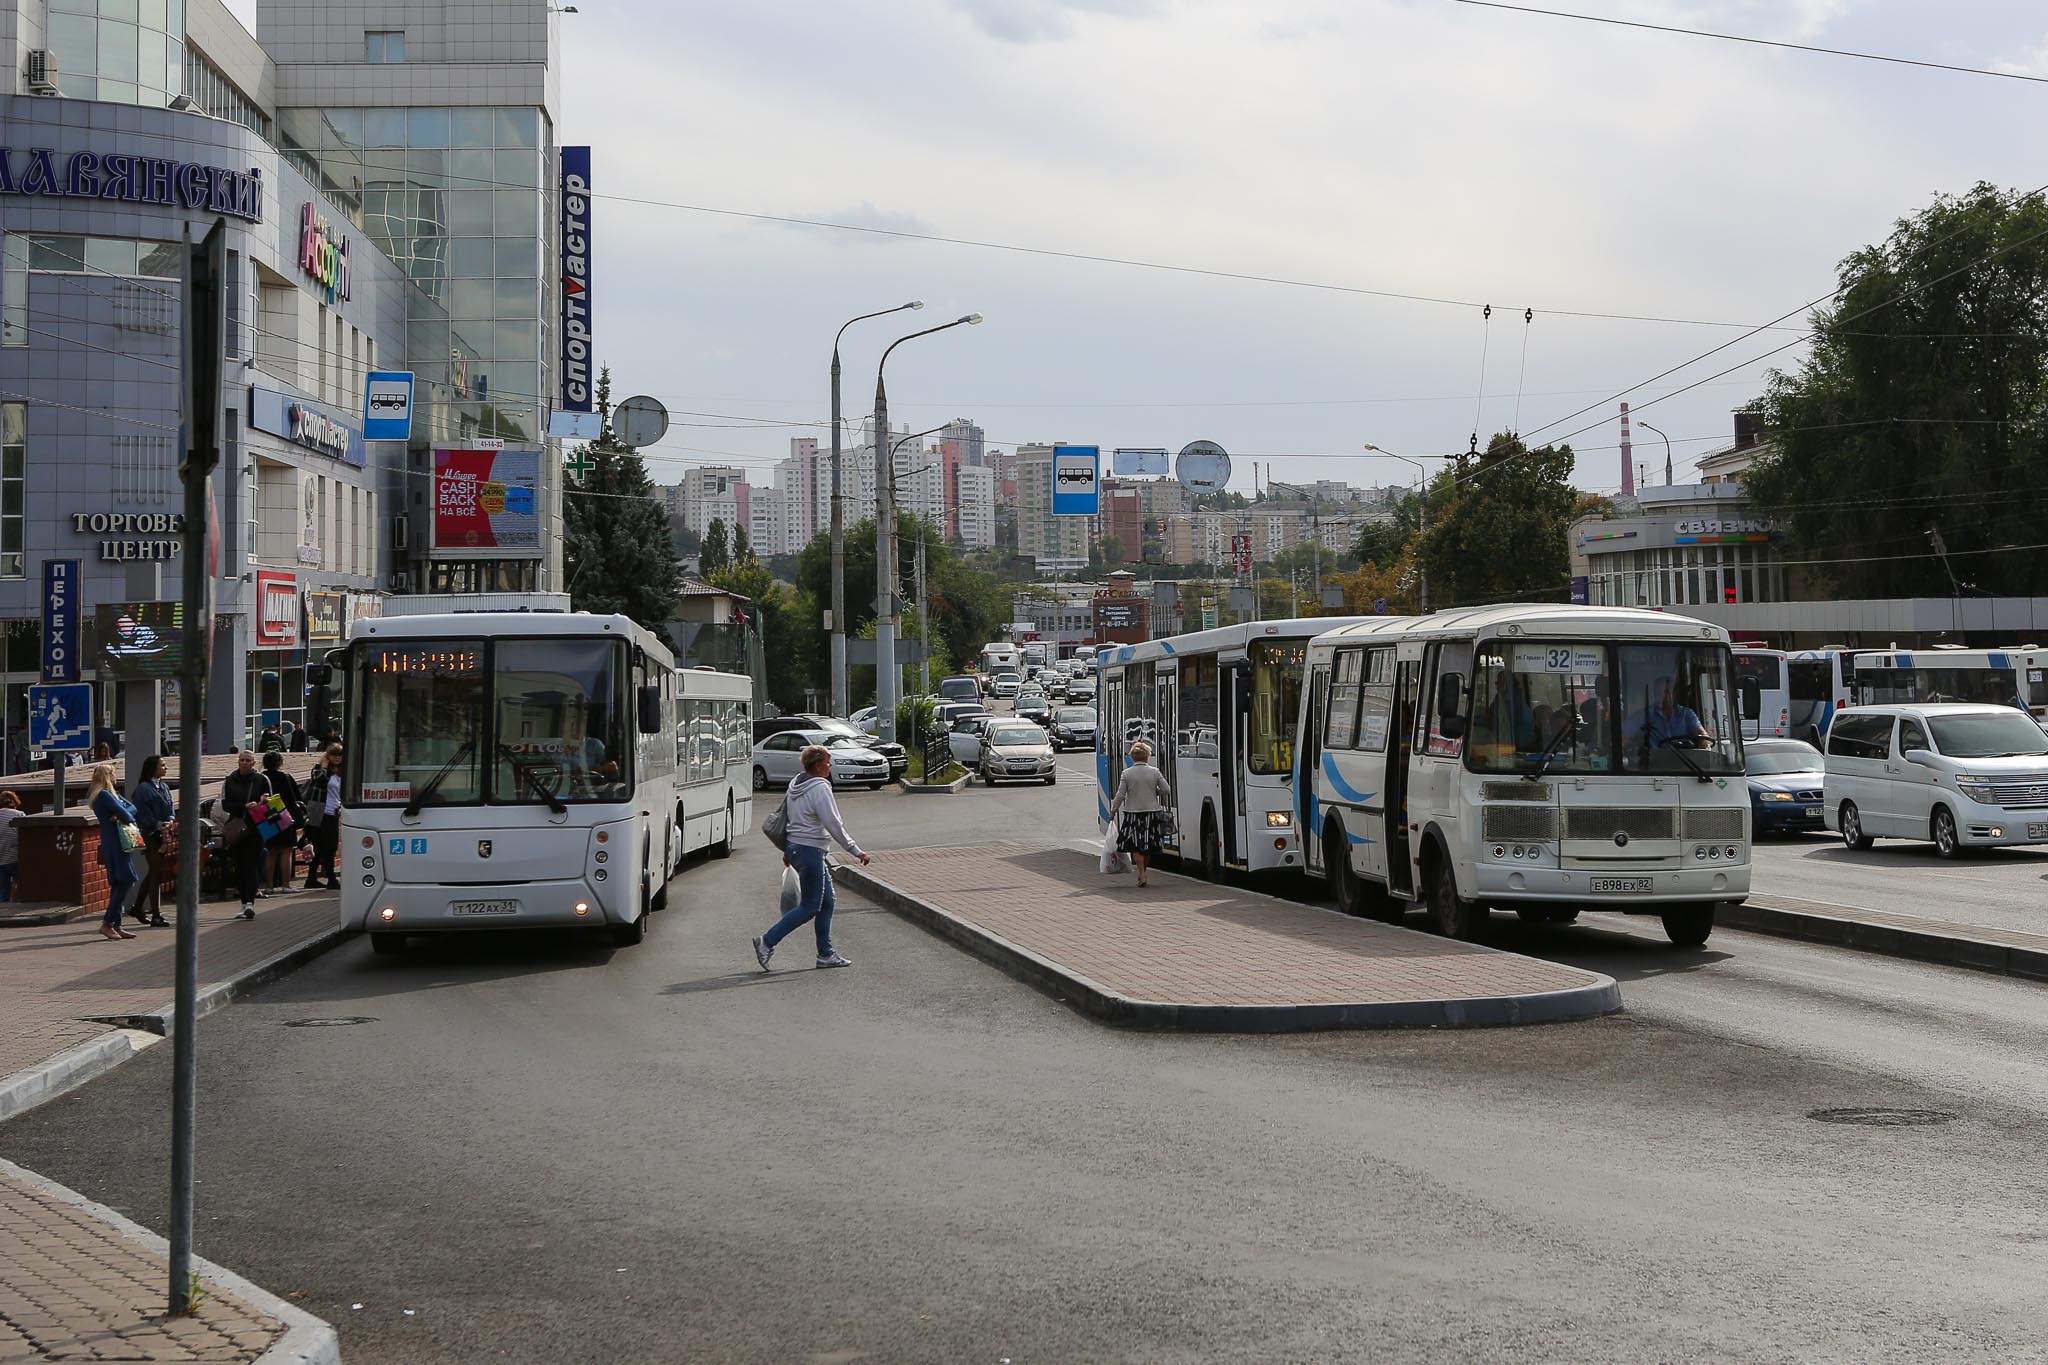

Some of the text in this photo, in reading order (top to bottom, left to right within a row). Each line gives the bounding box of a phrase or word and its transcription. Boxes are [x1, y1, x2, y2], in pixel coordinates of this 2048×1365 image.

[440, 482, 477, 494] CASH
[440, 494, 477, 505] BACK
[440, 506, 477, 516] НА ВСЁ
[101, 541, 182, 563] ЦЕНТР
[51, 563, 66, 678] ПЕРЕХОД
[1548, 649, 1570, 668] 32
[1271, 741, 1292, 770] 13
